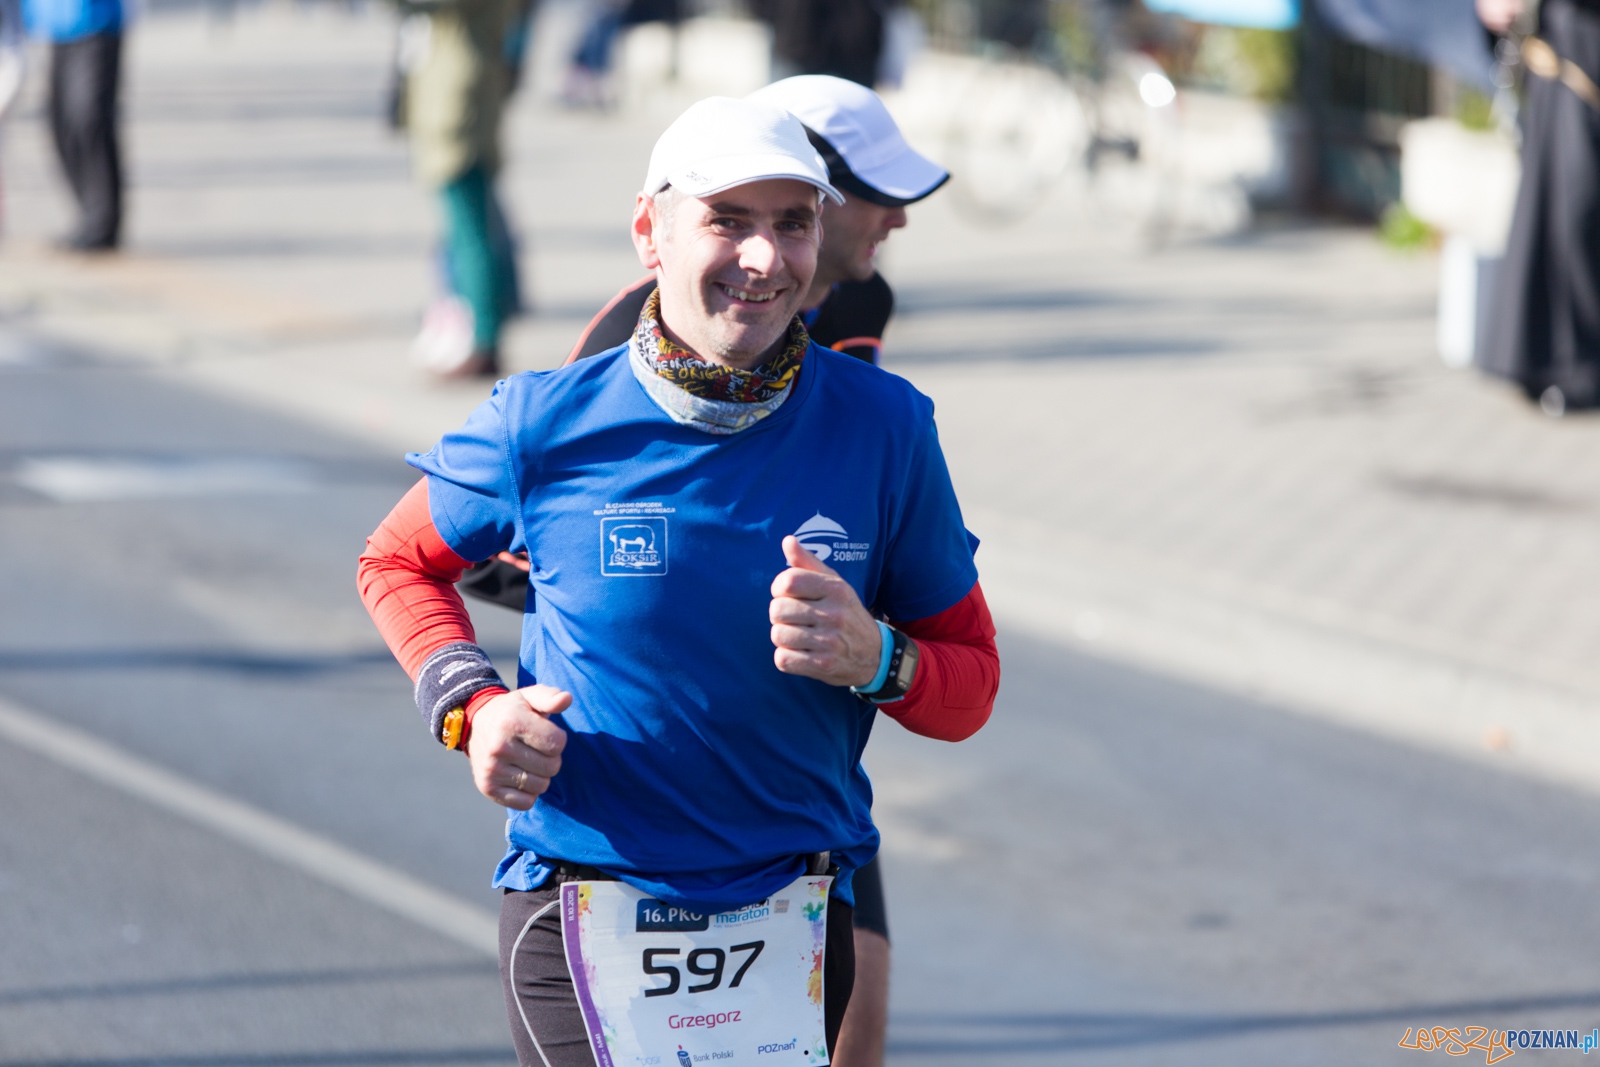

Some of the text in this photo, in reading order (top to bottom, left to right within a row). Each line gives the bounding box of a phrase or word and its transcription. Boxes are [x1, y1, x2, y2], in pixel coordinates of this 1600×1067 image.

[832, 542, 849, 550] KLUB
[642, 907, 666, 923] 16.
[716, 907, 770, 924] maraton
[642, 940, 765, 998] 597
[668, 1010, 742, 1029] Grzegorz
[693, 1052, 710, 1062] Bank
[712, 1050, 734, 1060] Polski
